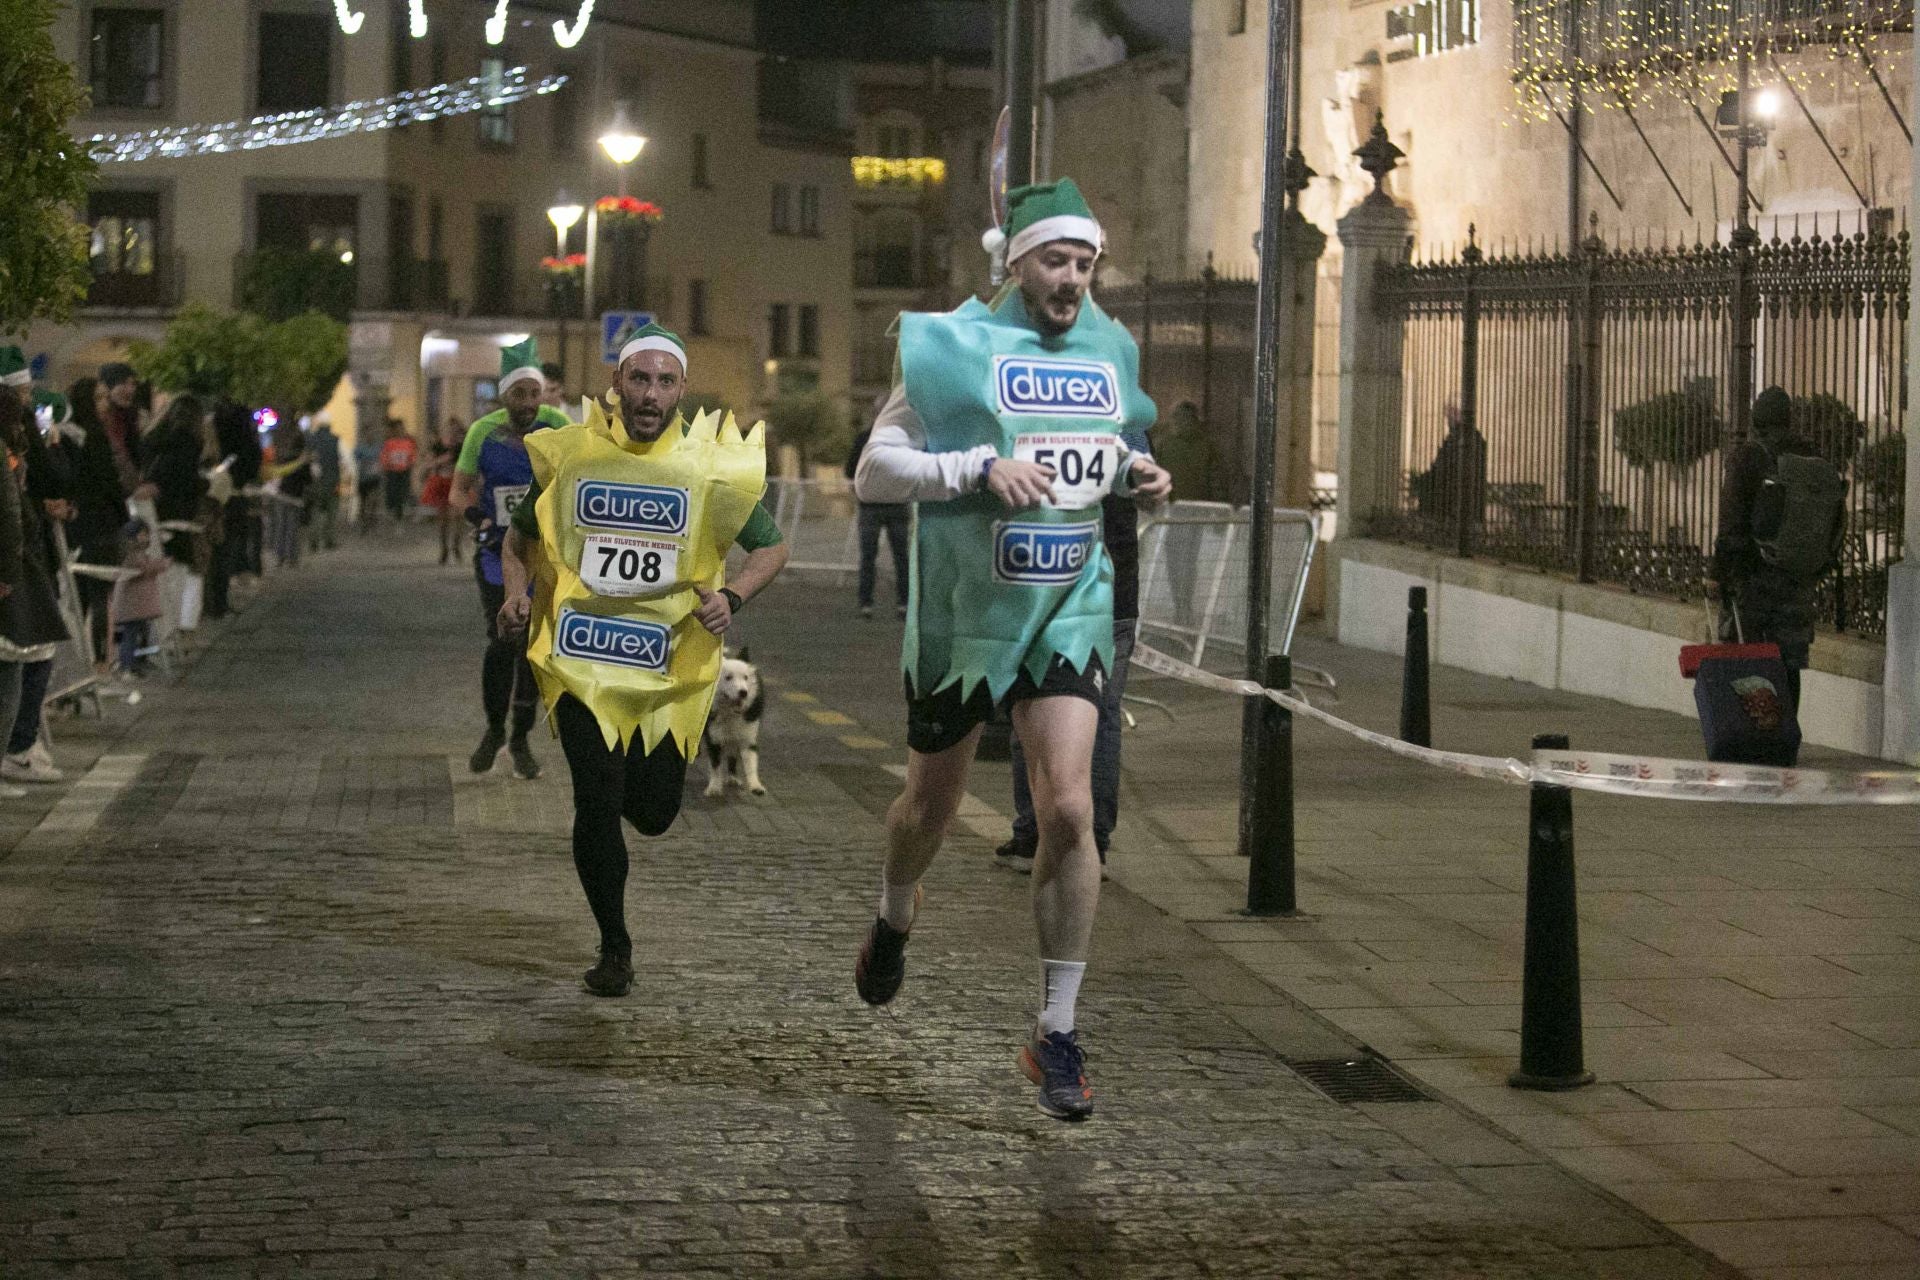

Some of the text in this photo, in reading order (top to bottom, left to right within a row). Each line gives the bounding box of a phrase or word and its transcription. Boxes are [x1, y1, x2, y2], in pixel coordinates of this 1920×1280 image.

[1012, 366, 1107, 411] durex
[1034, 449, 1104, 487] 504
[589, 487, 677, 529] durex
[600, 536, 612, 544] SAN
[614, 538, 649, 548] SILVESTRE
[651, 542, 677, 551] MERIDA
[598, 547, 661, 583] 708
[572, 619, 658, 665] durex
